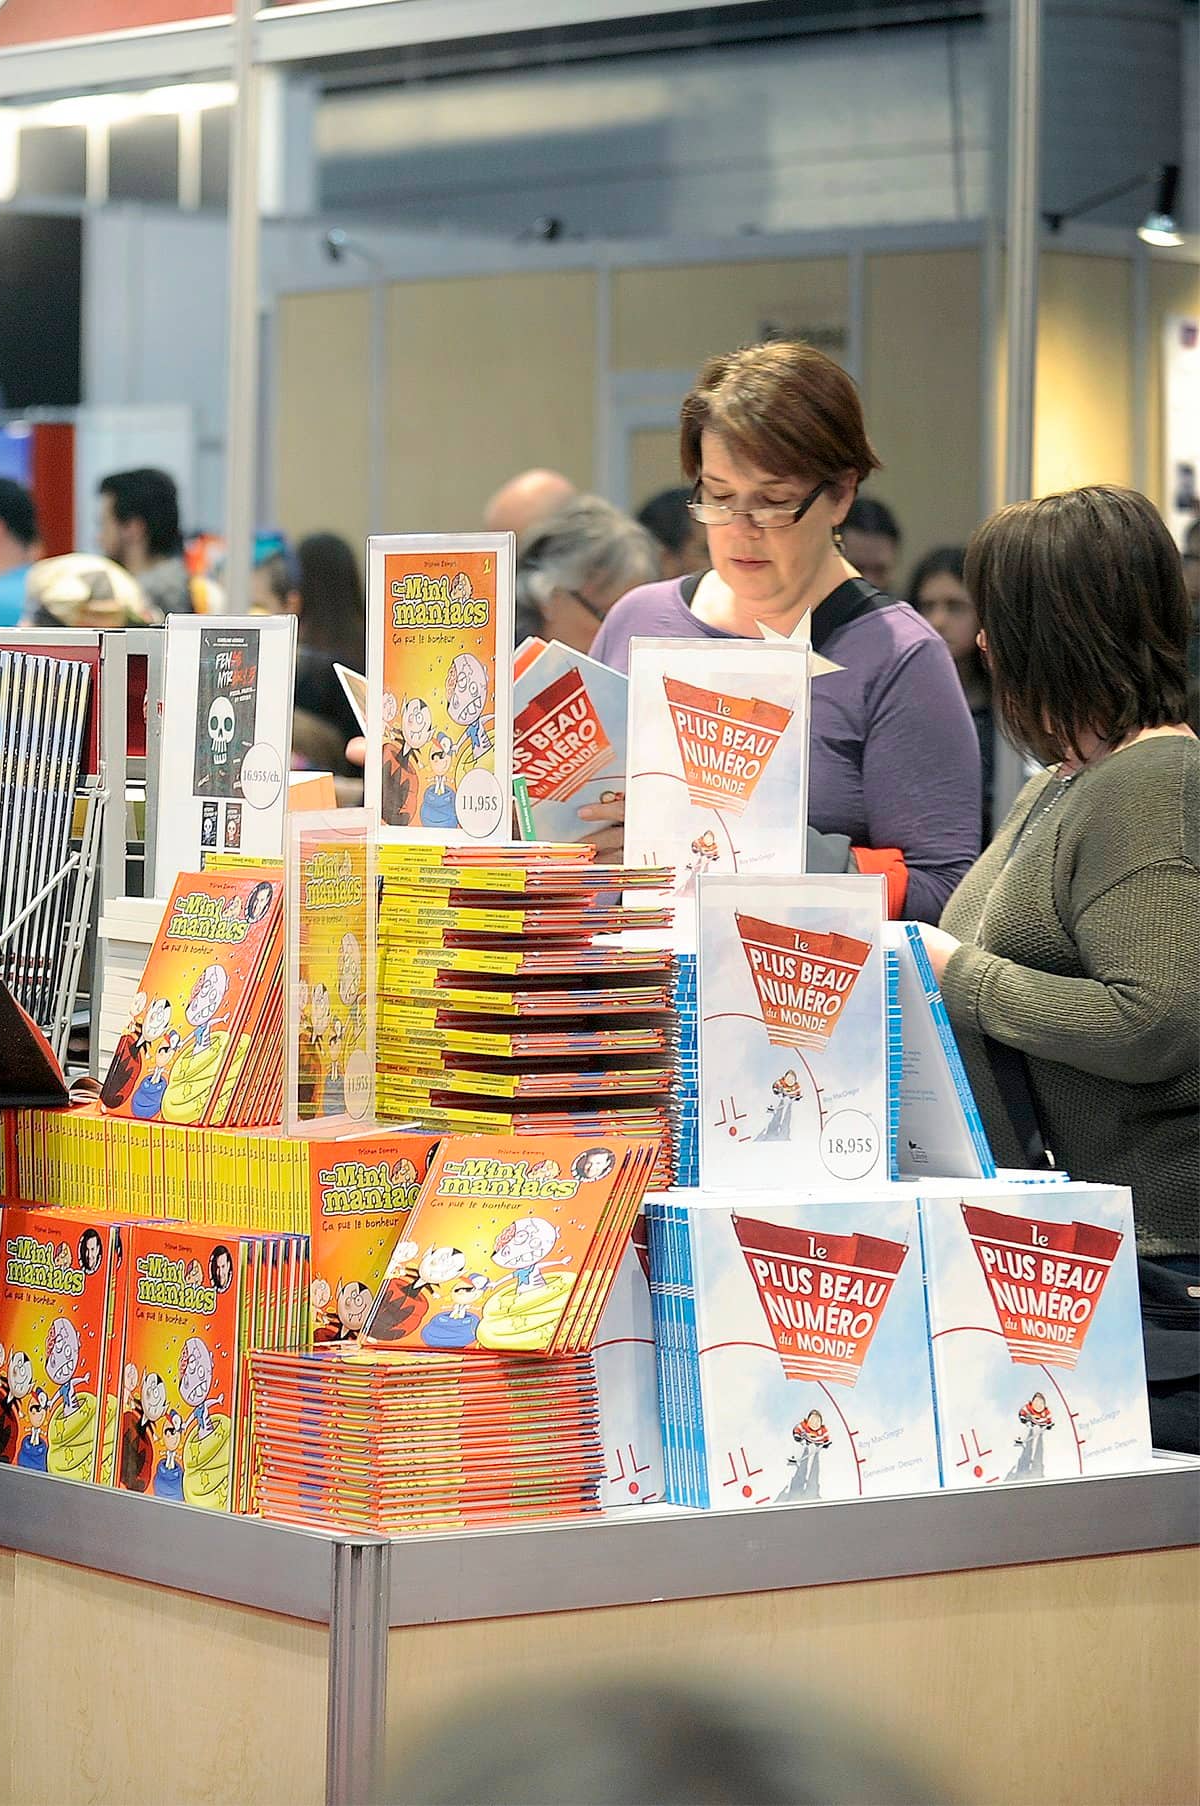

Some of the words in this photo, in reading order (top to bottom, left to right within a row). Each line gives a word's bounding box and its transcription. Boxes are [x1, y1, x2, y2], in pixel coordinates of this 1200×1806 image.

[405, 575, 448, 602] Mini
[393, 600, 488, 626] maniacs
[717, 697, 731, 716] le
[528, 698, 588, 751] BEAU
[675, 711, 718, 742] PLUS
[721, 725, 772, 757] BEAU
[546, 741, 599, 784] MONDE
[680, 736, 761, 780] NUMÉRO
[702, 770, 745, 794] MONDE
[461, 794, 498, 813] 11,95$
[185, 893, 223, 920] Mini
[169, 915, 249, 942] maniacs
[792, 933, 809, 952] le
[749, 947, 797, 980] PLUS
[800, 962, 853, 993] BEAU
[756, 974, 842, 1016] NUMÉRO
[766, 1007, 777, 1019] du
[780, 1007, 828, 1032] MONDE
[828, 1137, 873, 1155] 18,95$
[335, 1164, 388, 1190] Mini
[461, 1159, 527, 1180] Mini
[438, 1176, 578, 1199] maniacs
[365, 1216, 400, 1228] bonheur
[1030, 1224, 1049, 1247] le
[17, 1237, 54, 1264] Mini
[808, 1236, 828, 1259] le
[7, 1260, 84, 1293] maniacs
[147, 1255, 185, 1283] Mini
[979, 1245, 1037, 1282] PLUS
[1041, 1259, 1104, 1294] BEAU
[138, 1279, 216, 1313] maniacs
[752, 1258, 814, 1295] PLUS
[819, 1272, 887, 1308] BEAU
[990, 1277, 1091, 1324] NUMÉRO
[763, 1291, 874, 1339] NUMÉRO
[1004, 1317, 1018, 1331] du
[1020, 1317, 1078, 1344] MONDE
[778, 1332, 792, 1346] du
[796, 1331, 858, 1359] MONDE
